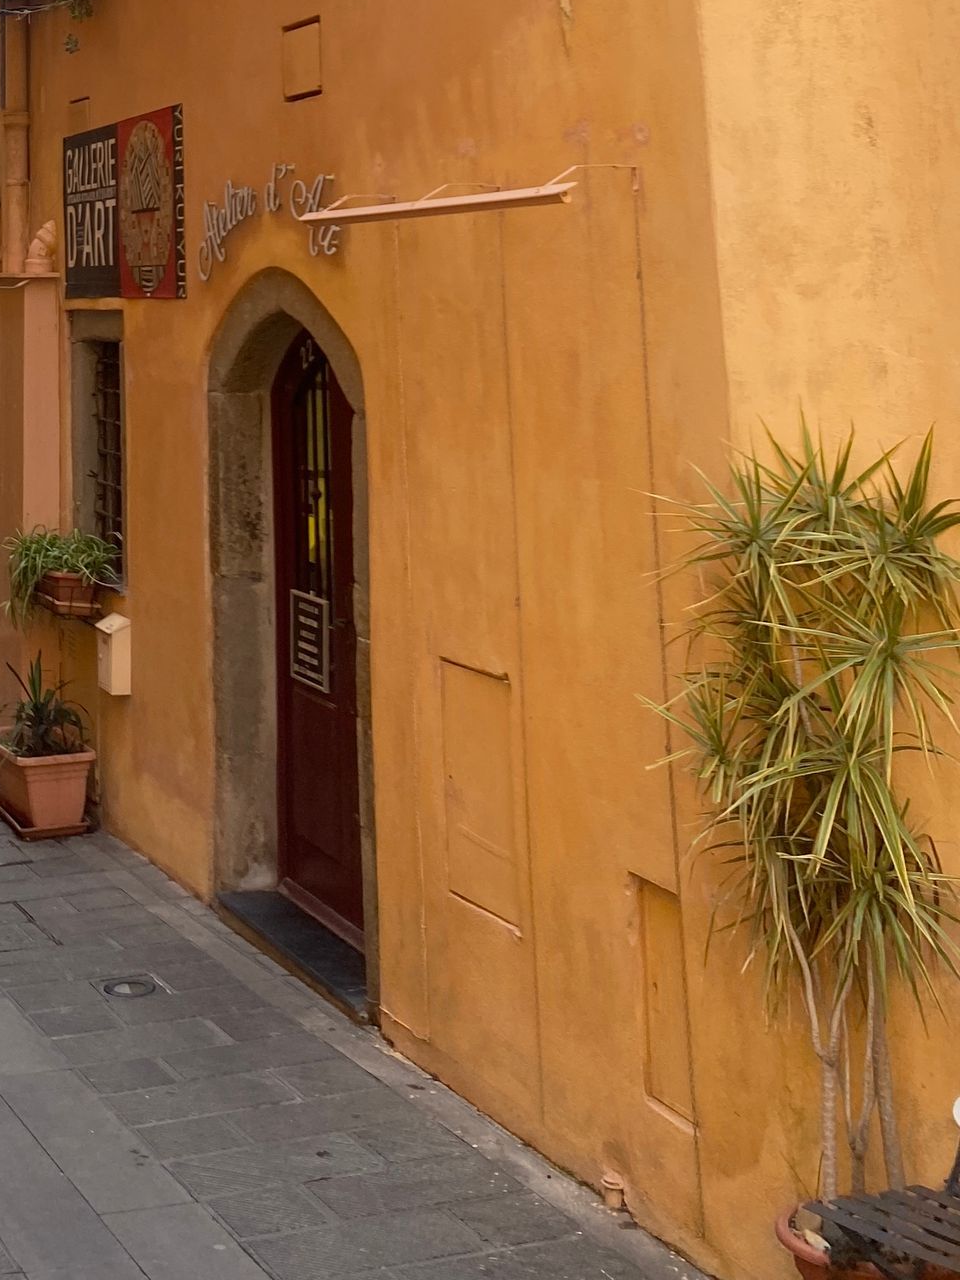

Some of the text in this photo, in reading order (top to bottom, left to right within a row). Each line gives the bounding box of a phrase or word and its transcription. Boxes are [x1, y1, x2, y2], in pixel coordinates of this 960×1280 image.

[66, 138, 116, 195] GALLERIE
[66, 198, 117, 269] D'ART
[198, 179, 257, 282] Atelier
